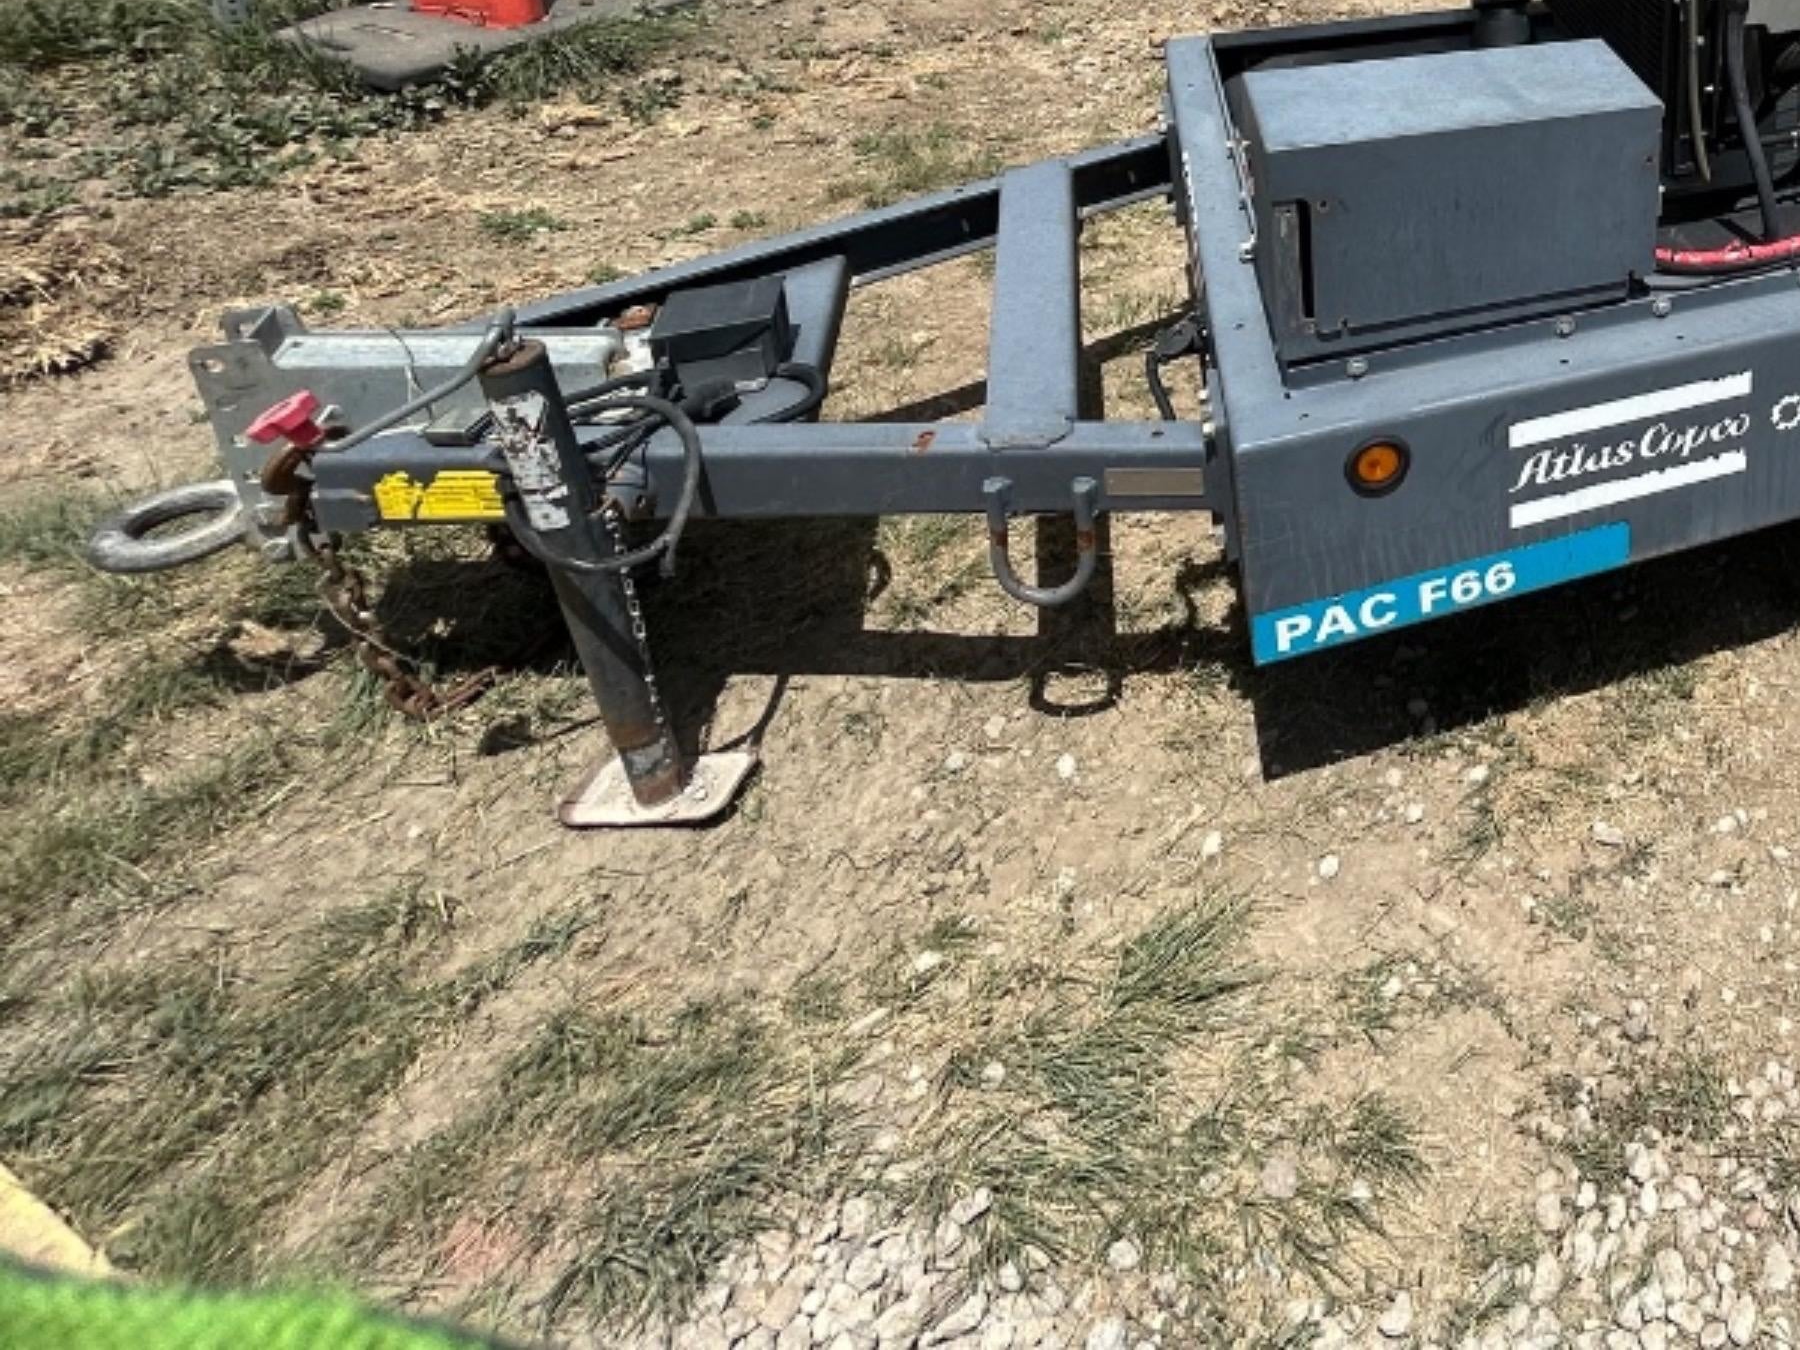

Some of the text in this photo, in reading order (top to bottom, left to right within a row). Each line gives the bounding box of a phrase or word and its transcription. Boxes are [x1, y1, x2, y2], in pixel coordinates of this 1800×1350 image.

[1508, 412, 1750, 494] Atlas Copco
[1274, 560, 1518, 653] PAC F66
